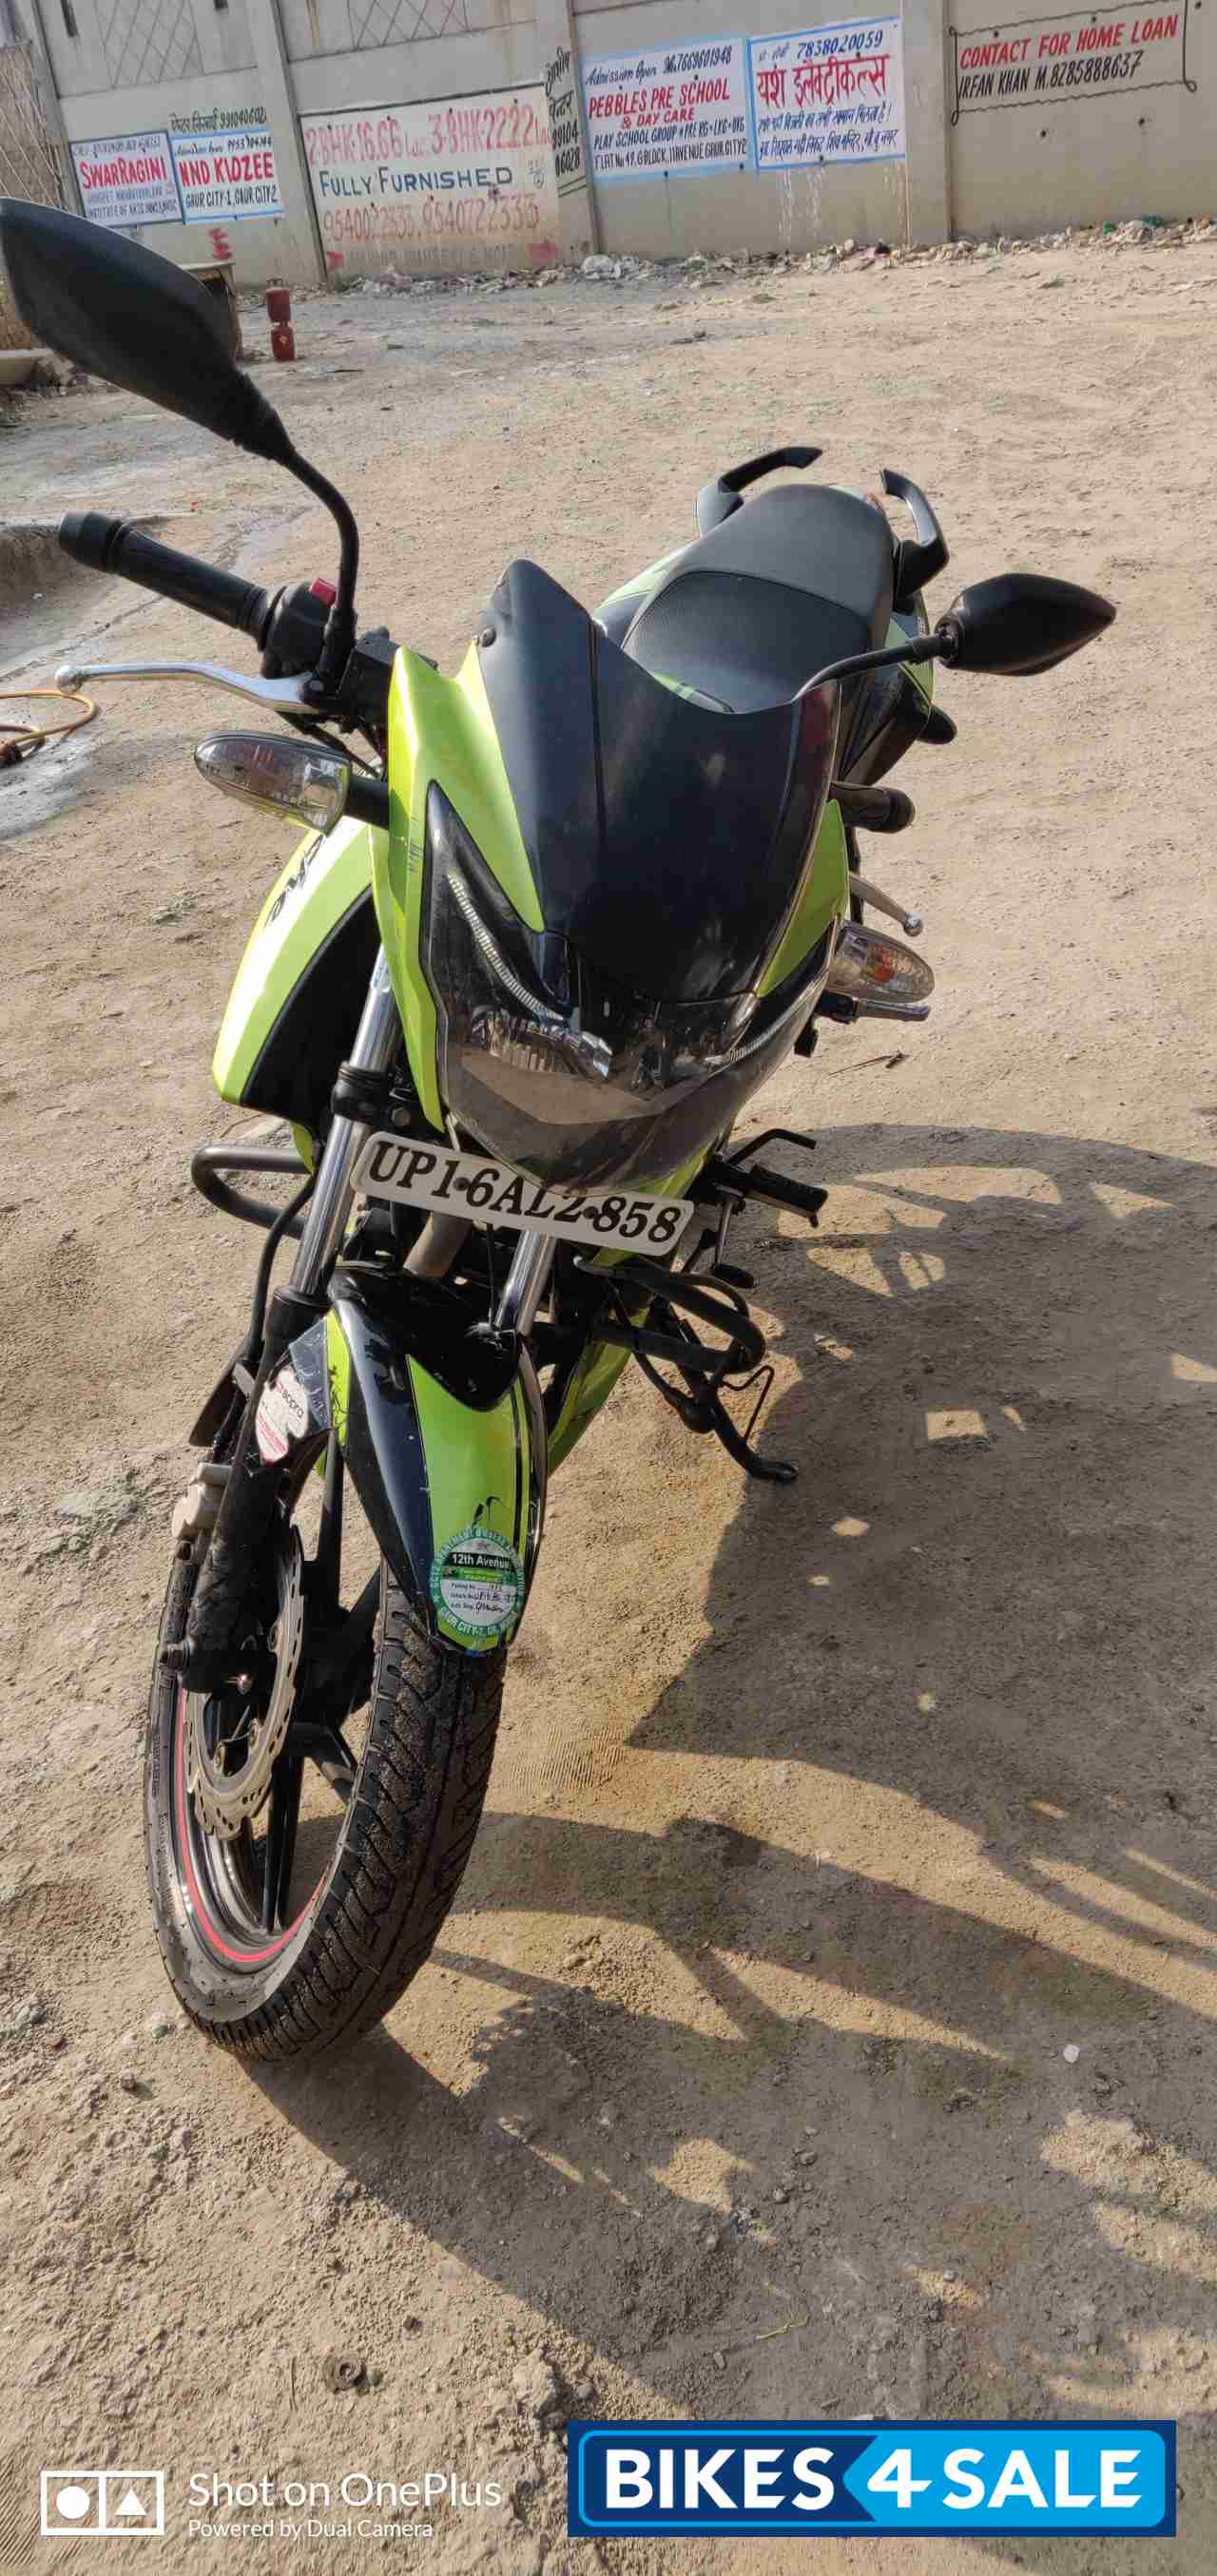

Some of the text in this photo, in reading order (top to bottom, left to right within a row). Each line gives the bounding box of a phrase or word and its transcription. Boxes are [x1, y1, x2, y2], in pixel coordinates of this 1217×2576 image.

[797, 29, 883, 60] 7838020059
[959, 14, 1179, 69] CONTACT FOR HOME LOAN
[589, 77, 731, 120] PEBBLES PRE SCHOOL
[957, 75, 995, 101] IRFAN
[997, 67, 1031, 96] KHAN
[637, 112, 661, 127] DAY
[665, 106, 696, 123] CARE
[594, 132, 614, 149] PLAY
[616, 126, 649, 147] SCHOOL
[650, 124, 678, 144] GROUP
[319, 169, 372, 197] FULLY
[379, 165, 513, 194] FURNISHED
[452, 1553, 475, 1567] 12th
